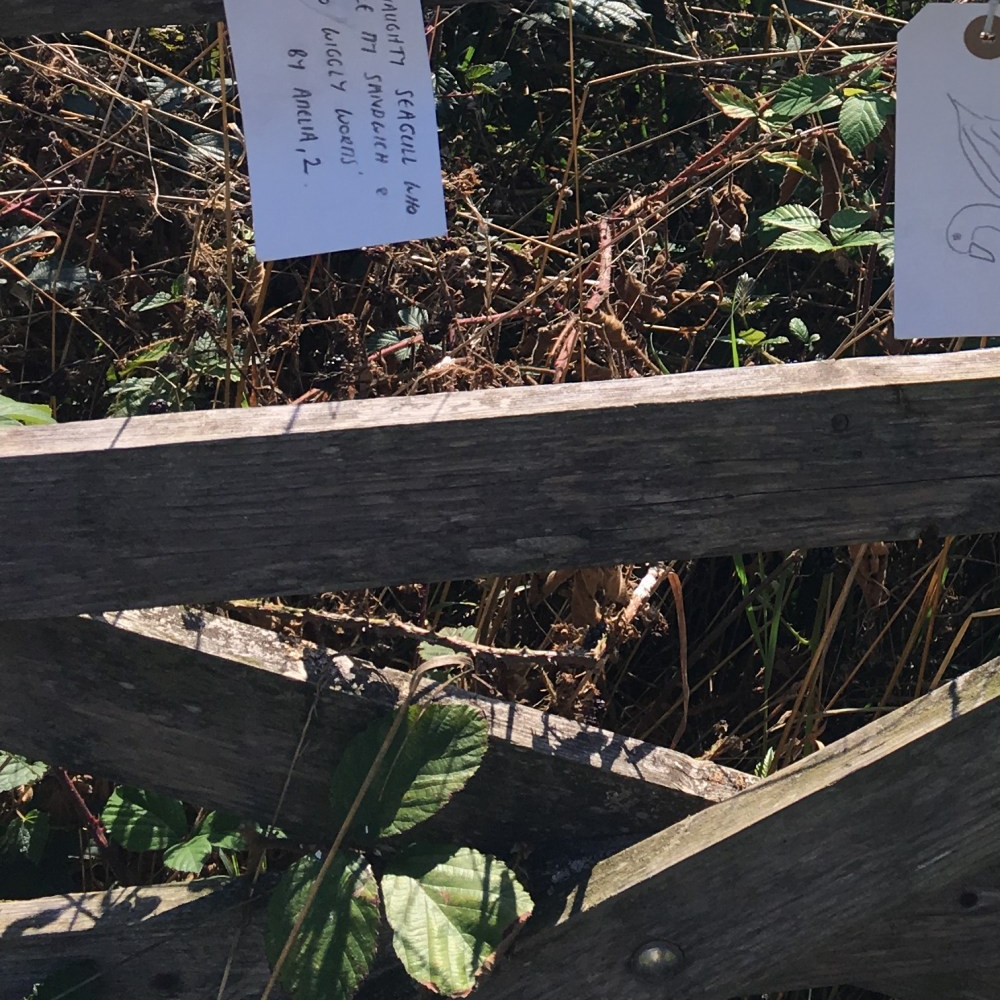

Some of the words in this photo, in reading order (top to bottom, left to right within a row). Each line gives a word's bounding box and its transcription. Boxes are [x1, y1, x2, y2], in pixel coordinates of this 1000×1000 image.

[321, 27, 347, 92] WIGGLY
[361, 31, 379, 54] MY
[287, 48, 307, 70] BY
[303, 157, 320, 175] 2
[364, 72, 387, 164] SANDWICH
[395, 88, 415, 165] SEAGULL
[404, 181, 421, 215] WHO
